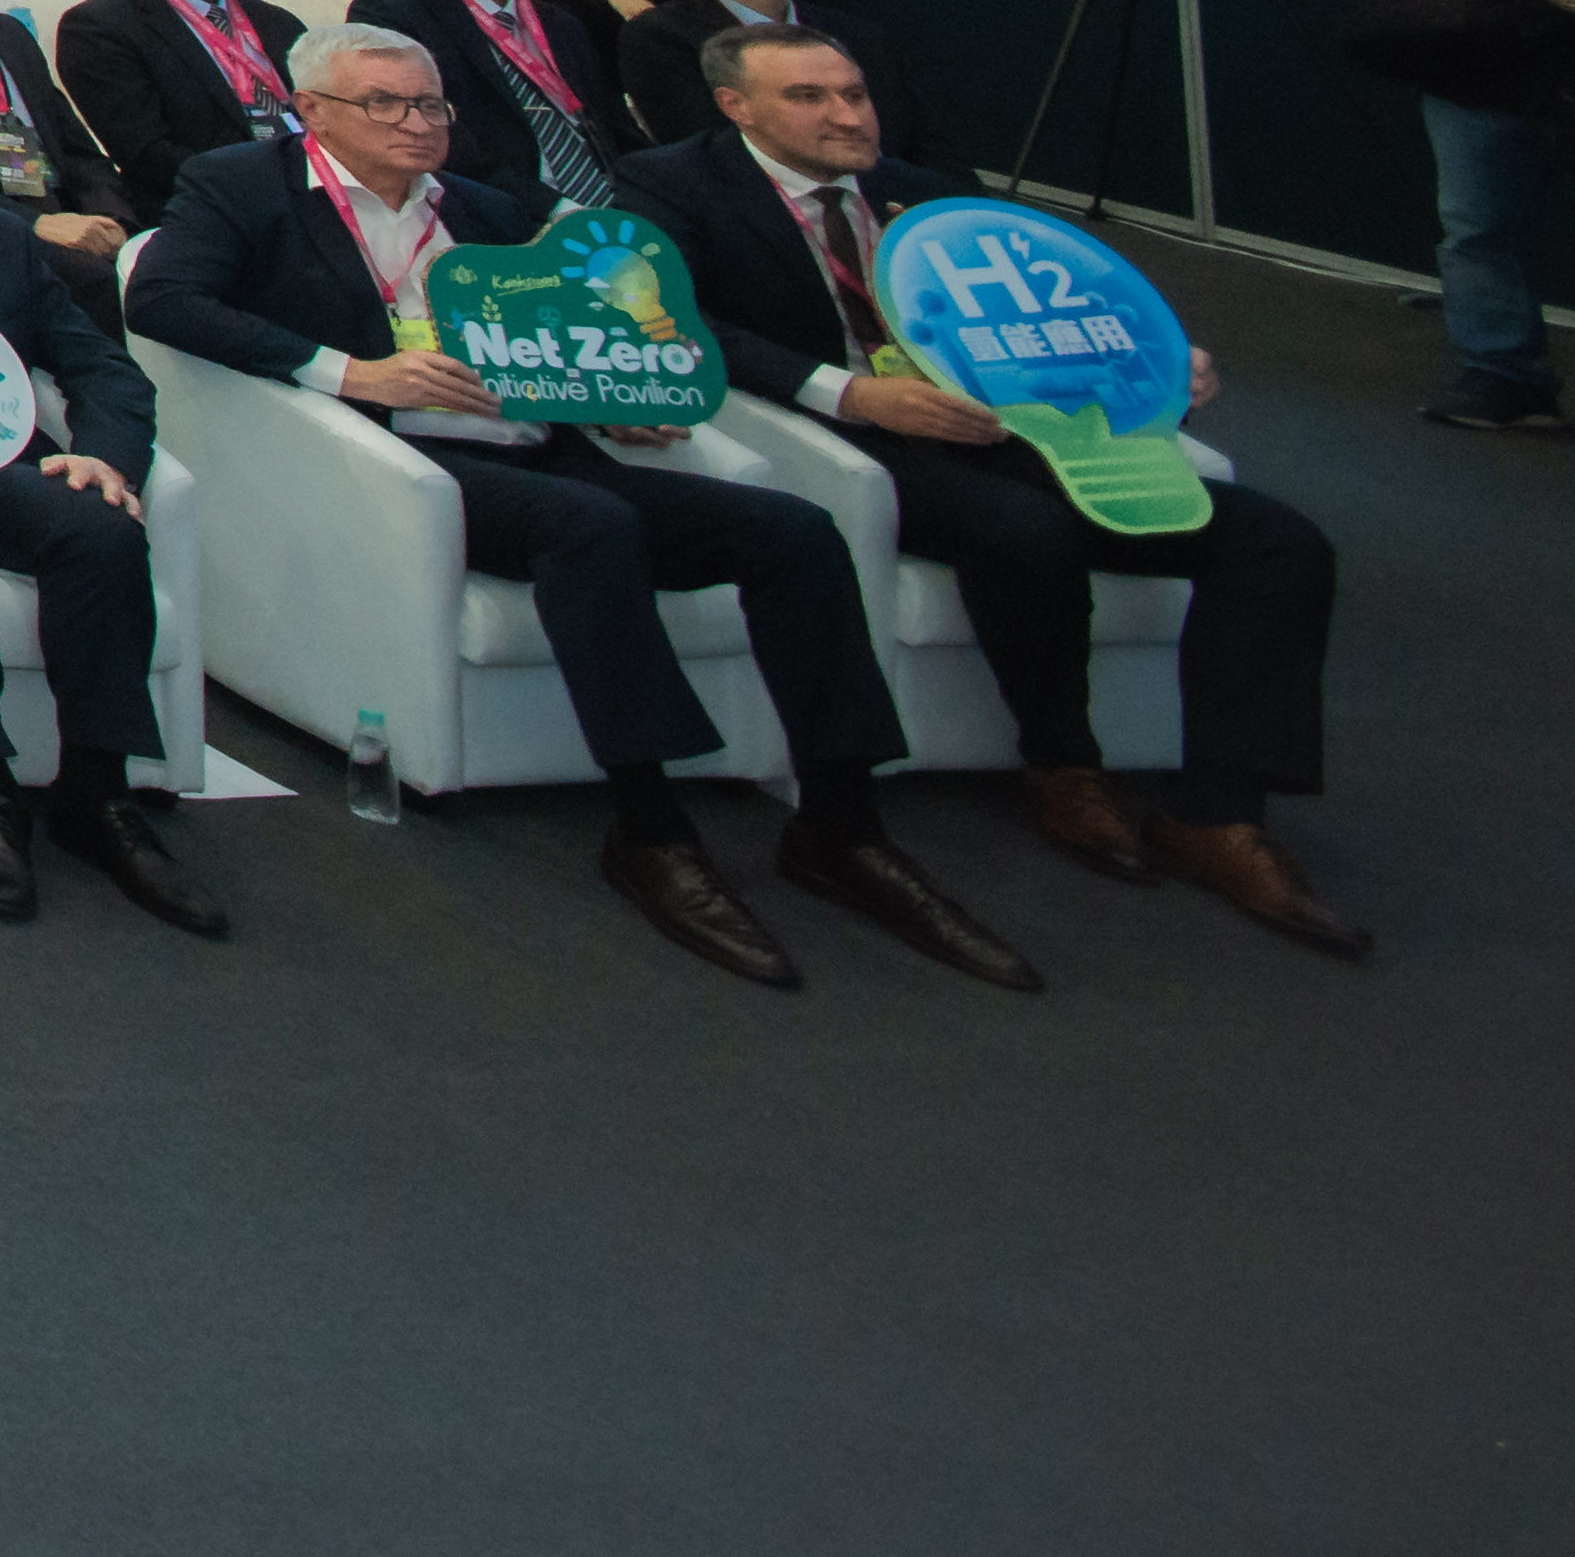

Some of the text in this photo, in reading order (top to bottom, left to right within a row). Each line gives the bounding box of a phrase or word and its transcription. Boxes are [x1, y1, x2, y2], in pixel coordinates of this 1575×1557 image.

[462, 320, 697, 375] Net Zero
[958, 314, 1137, 362] 氫能應用
[474, 370, 706, 408] nitiative Pavilion
